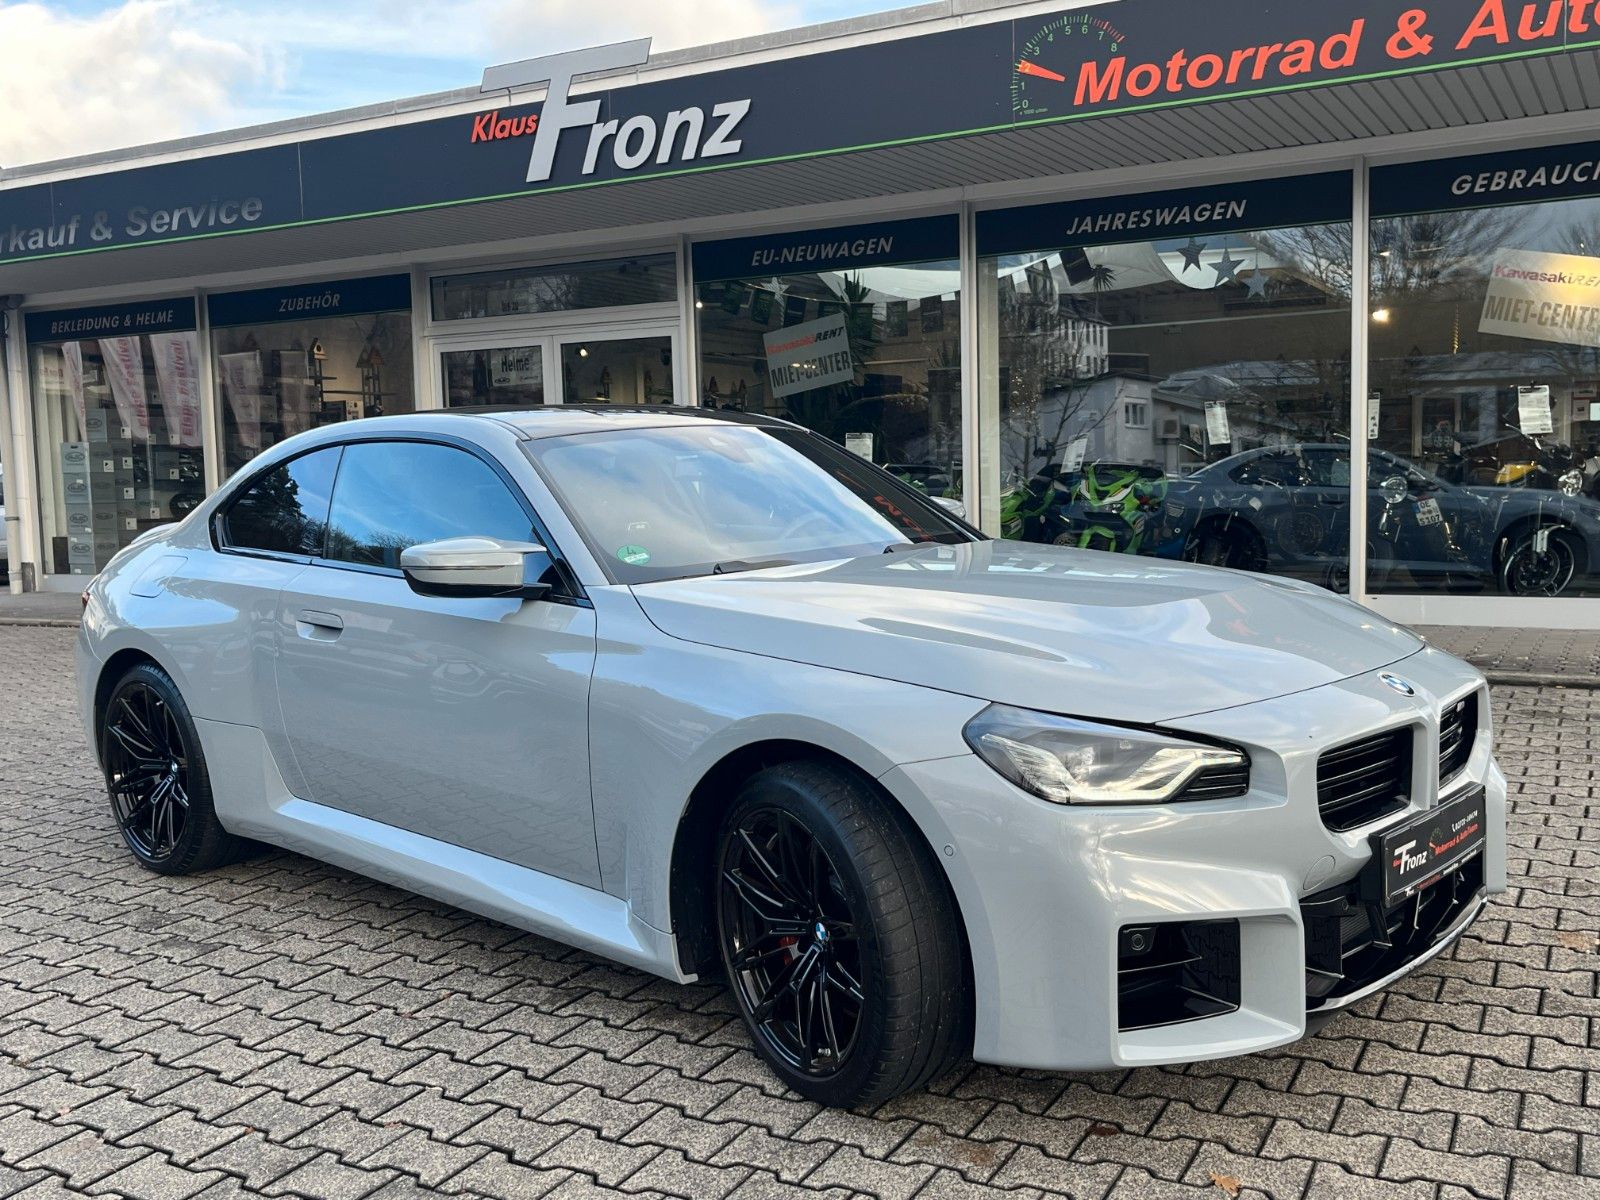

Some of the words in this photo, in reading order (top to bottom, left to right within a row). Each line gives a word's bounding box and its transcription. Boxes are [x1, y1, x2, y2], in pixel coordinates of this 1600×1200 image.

[1065, 25, 1071, 35] 5
[1081, 25, 1089, 34] 6
[1098, 31, 1104, 41] 7
[1033, 46, 1041, 56] 3
[1073, 18, 1365, 105] Motorrad
[1385, 9, 1434, 59] &
[1110, 42, 1118, 53] 8
[480, 37, 751, 183] Fronz
[1022, 99, 1029, 108] 0
[471, 111, 538, 143] Klaus
[90, 212, 112, 242] &
[126, 197, 263, 237] Service
[1066, 200, 1247, 236] JAHRESWAGEN
[752, 237, 894, 266] EU-NEUWAGEN
[279, 291, 340, 313] ZUBEHÖR
[51, 315, 119, 334] BEKLEIDUNG
[124, 314, 131, 328] &
[136, 310, 174, 326] HELME
[814, 327, 844, 342] RENT
[1394, 840, 1427, 875] Fronz
